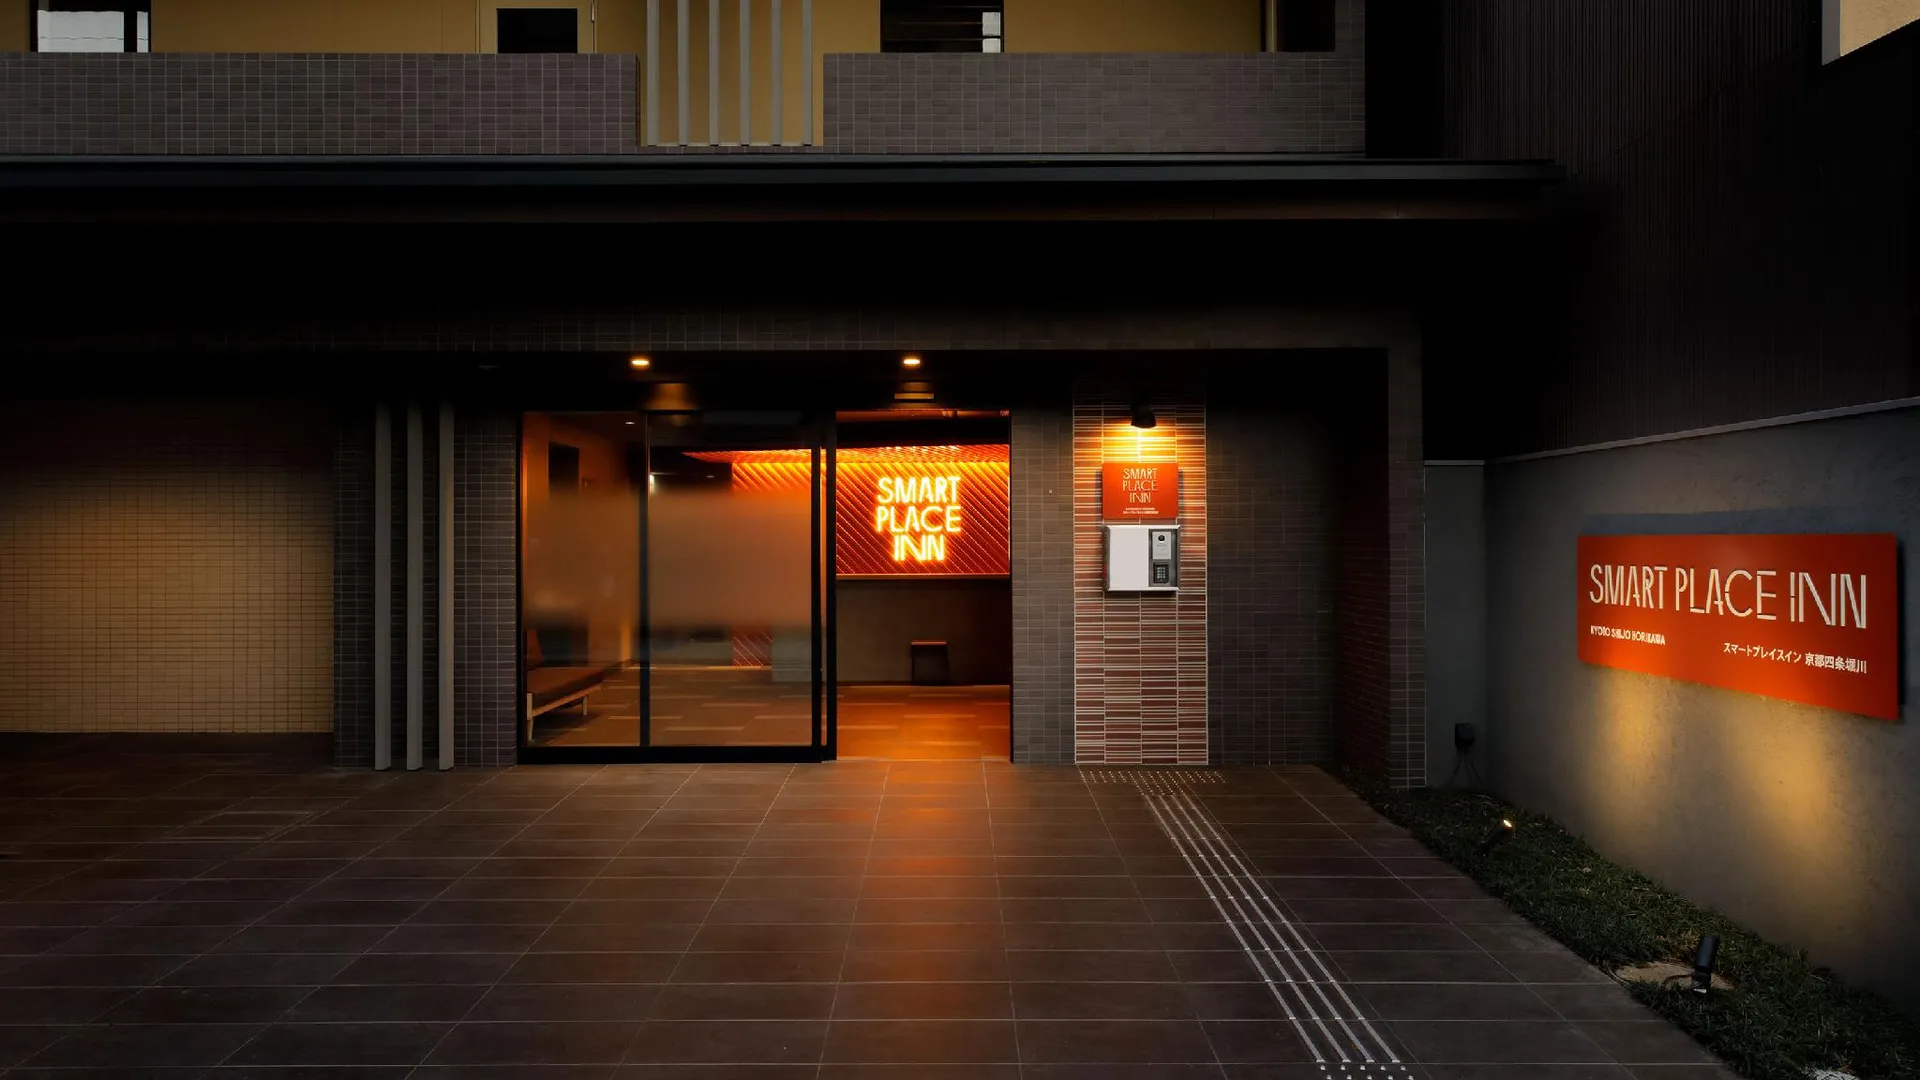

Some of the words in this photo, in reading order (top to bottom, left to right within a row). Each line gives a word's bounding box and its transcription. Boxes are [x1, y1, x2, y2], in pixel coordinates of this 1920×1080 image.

[1122, 480, 1158, 491] PLACE
[1123, 468, 1157, 480] SMART
[877, 476, 961, 504] SMART
[1129, 492, 1152, 504] INN
[877, 505, 961, 533] PLACE
[894, 534, 945, 561] INN
[1589, 564, 1667, 610] SMART
[1675, 567, 1777, 621] PLACE
[1790, 571, 1867, 629] INN
[1723, 642, 1802, 664] スマートプレイスイン
